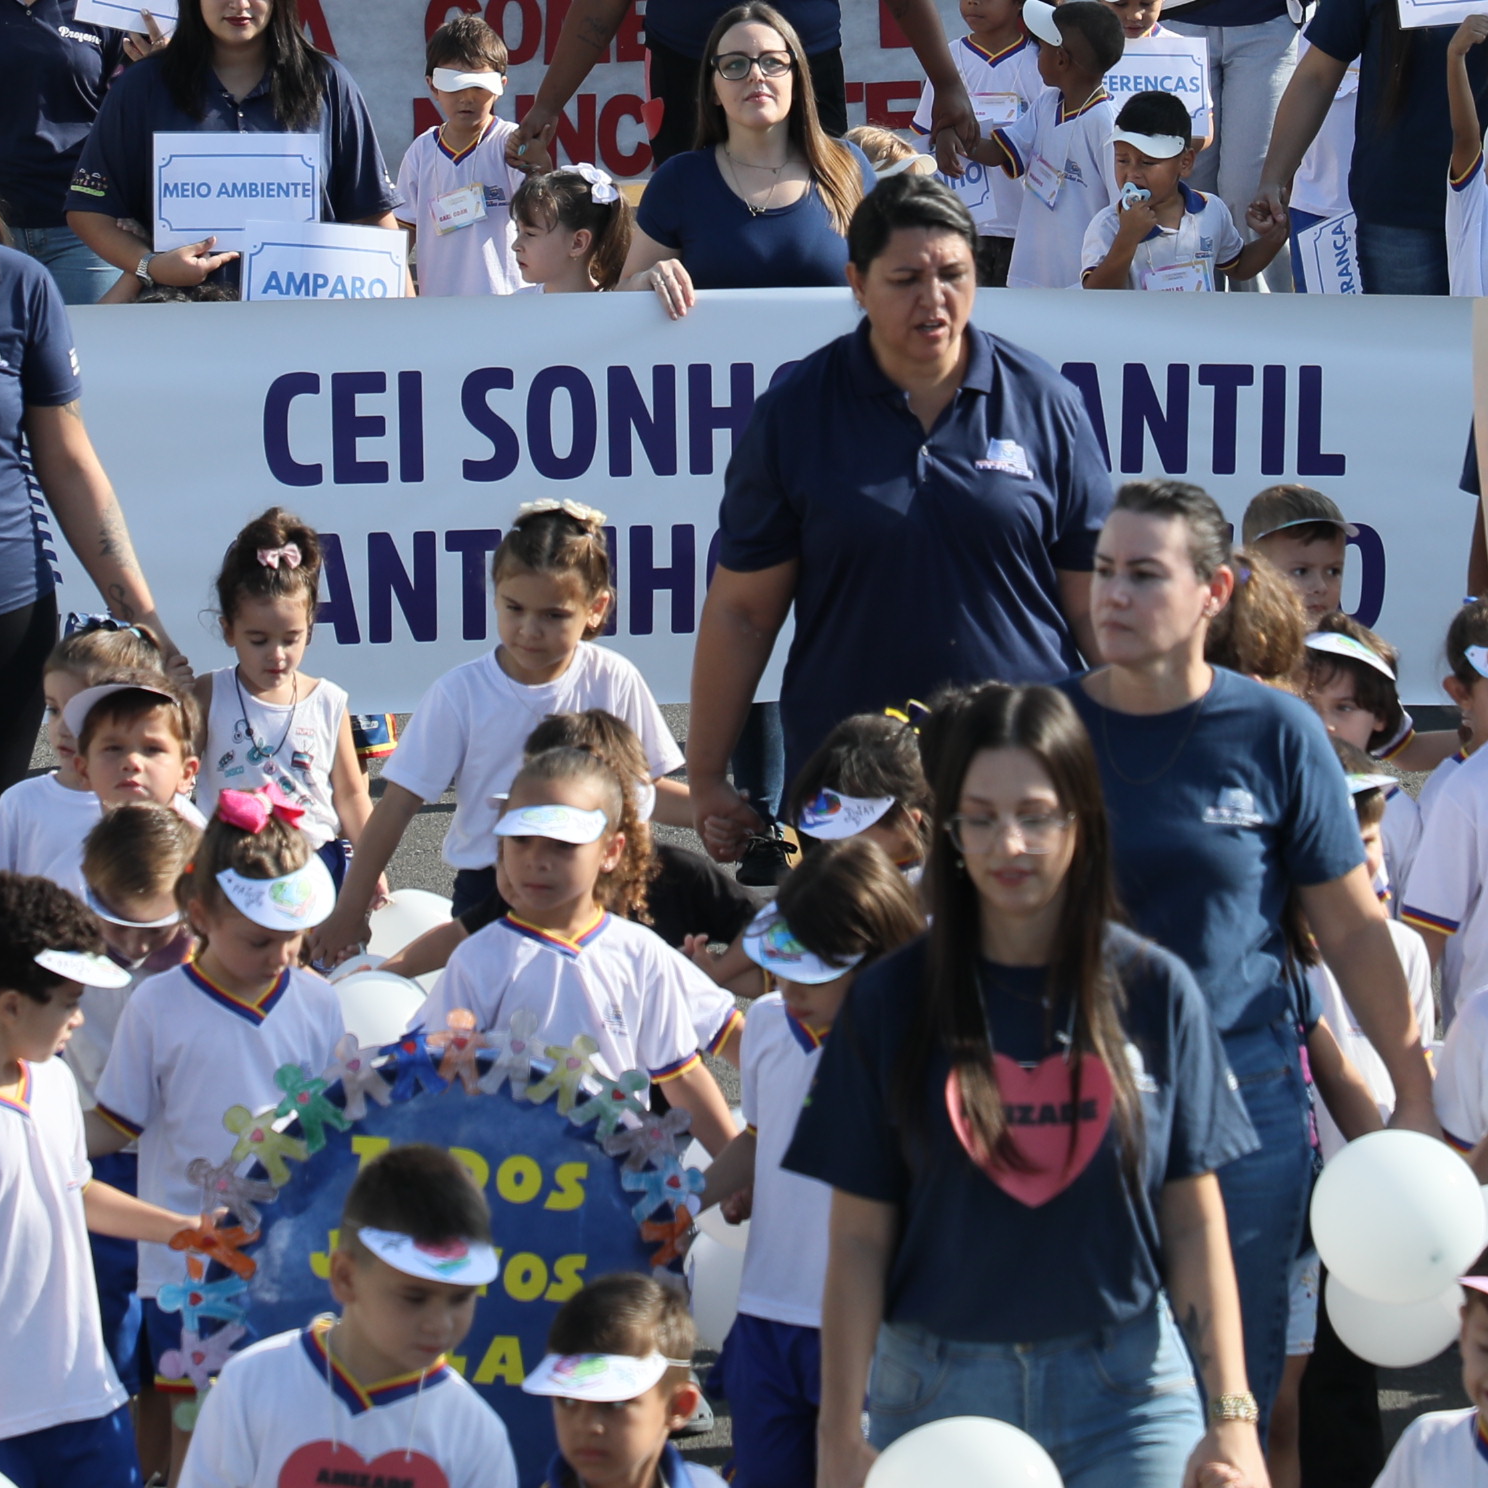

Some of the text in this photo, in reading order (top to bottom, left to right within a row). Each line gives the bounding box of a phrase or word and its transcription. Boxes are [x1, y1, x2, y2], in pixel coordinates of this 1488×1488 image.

[162, 180, 312, 199] MEIO AMBIENTE
[261, 269, 388, 300] AMPARO
[262, 369, 425, 488] CEI
[460, 360, 810, 484] SONH
